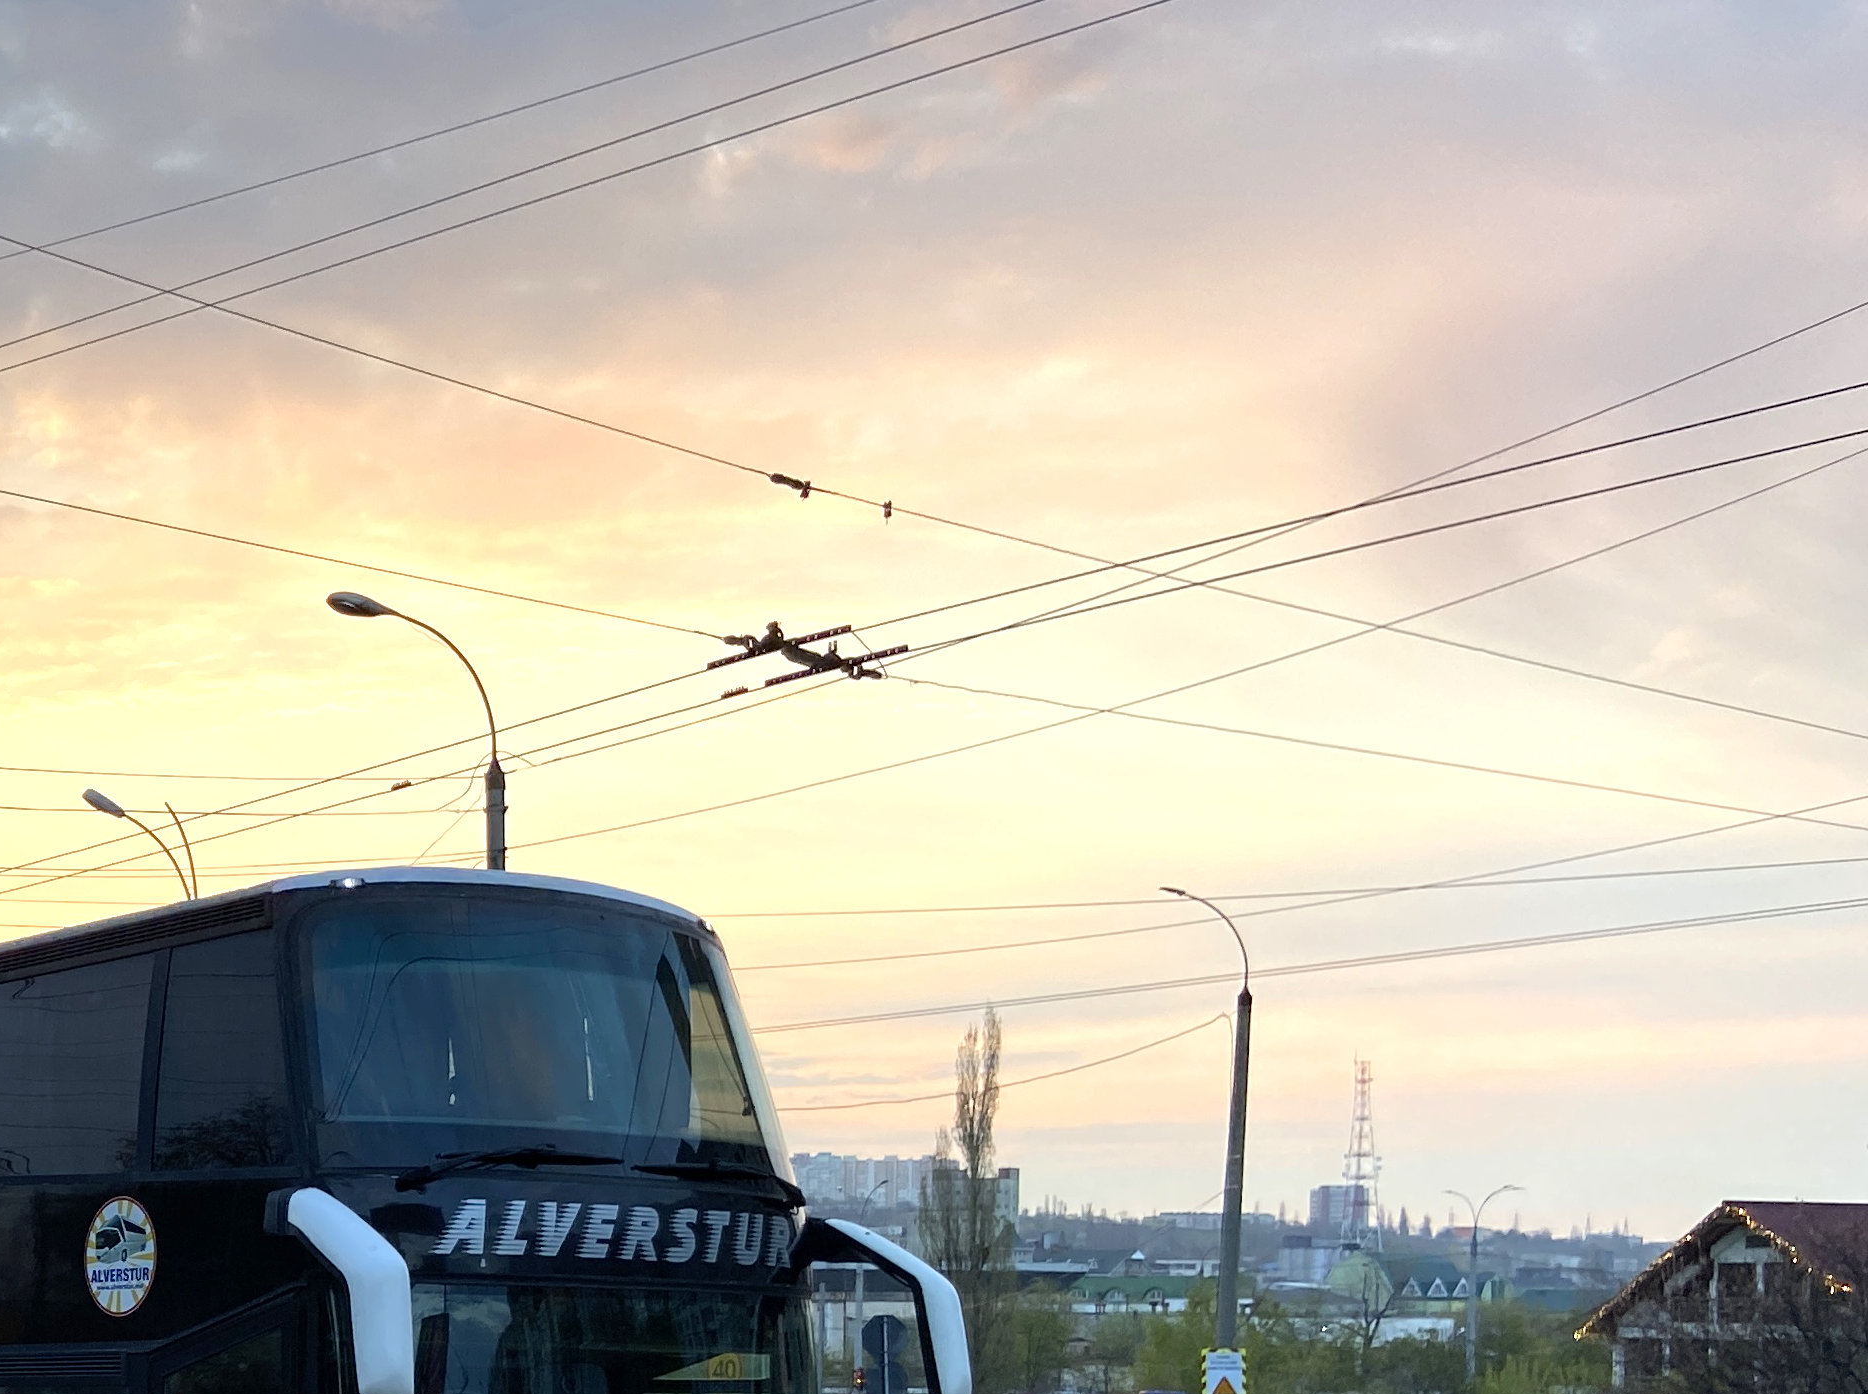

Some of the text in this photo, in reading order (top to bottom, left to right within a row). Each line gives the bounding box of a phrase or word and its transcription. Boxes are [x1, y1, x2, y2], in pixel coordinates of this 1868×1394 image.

[431, 1198, 792, 1268] ALVERSTUR
[91, 1267, 150, 1283] ALVERSTUR
[712, 1360, 737, 1378] 40
